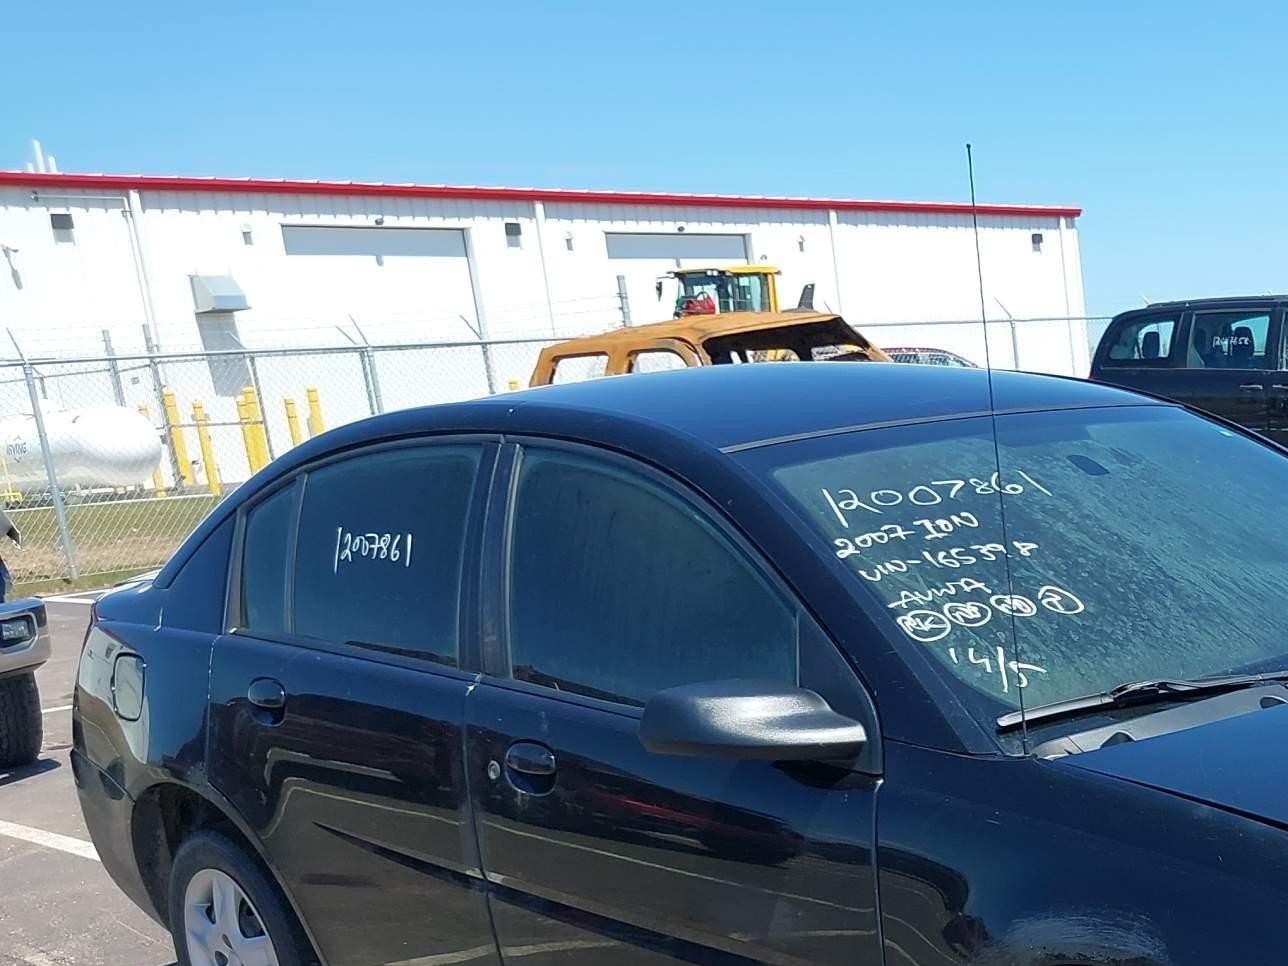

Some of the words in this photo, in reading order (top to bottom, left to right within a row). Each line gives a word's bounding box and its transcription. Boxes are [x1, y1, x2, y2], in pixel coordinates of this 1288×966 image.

[821, 470, 1053, 529] 12007861
[333, 526, 413, 575] 12007861
[834, 524, 916, 559] 2007
[913, 511, 979, 540] ION
